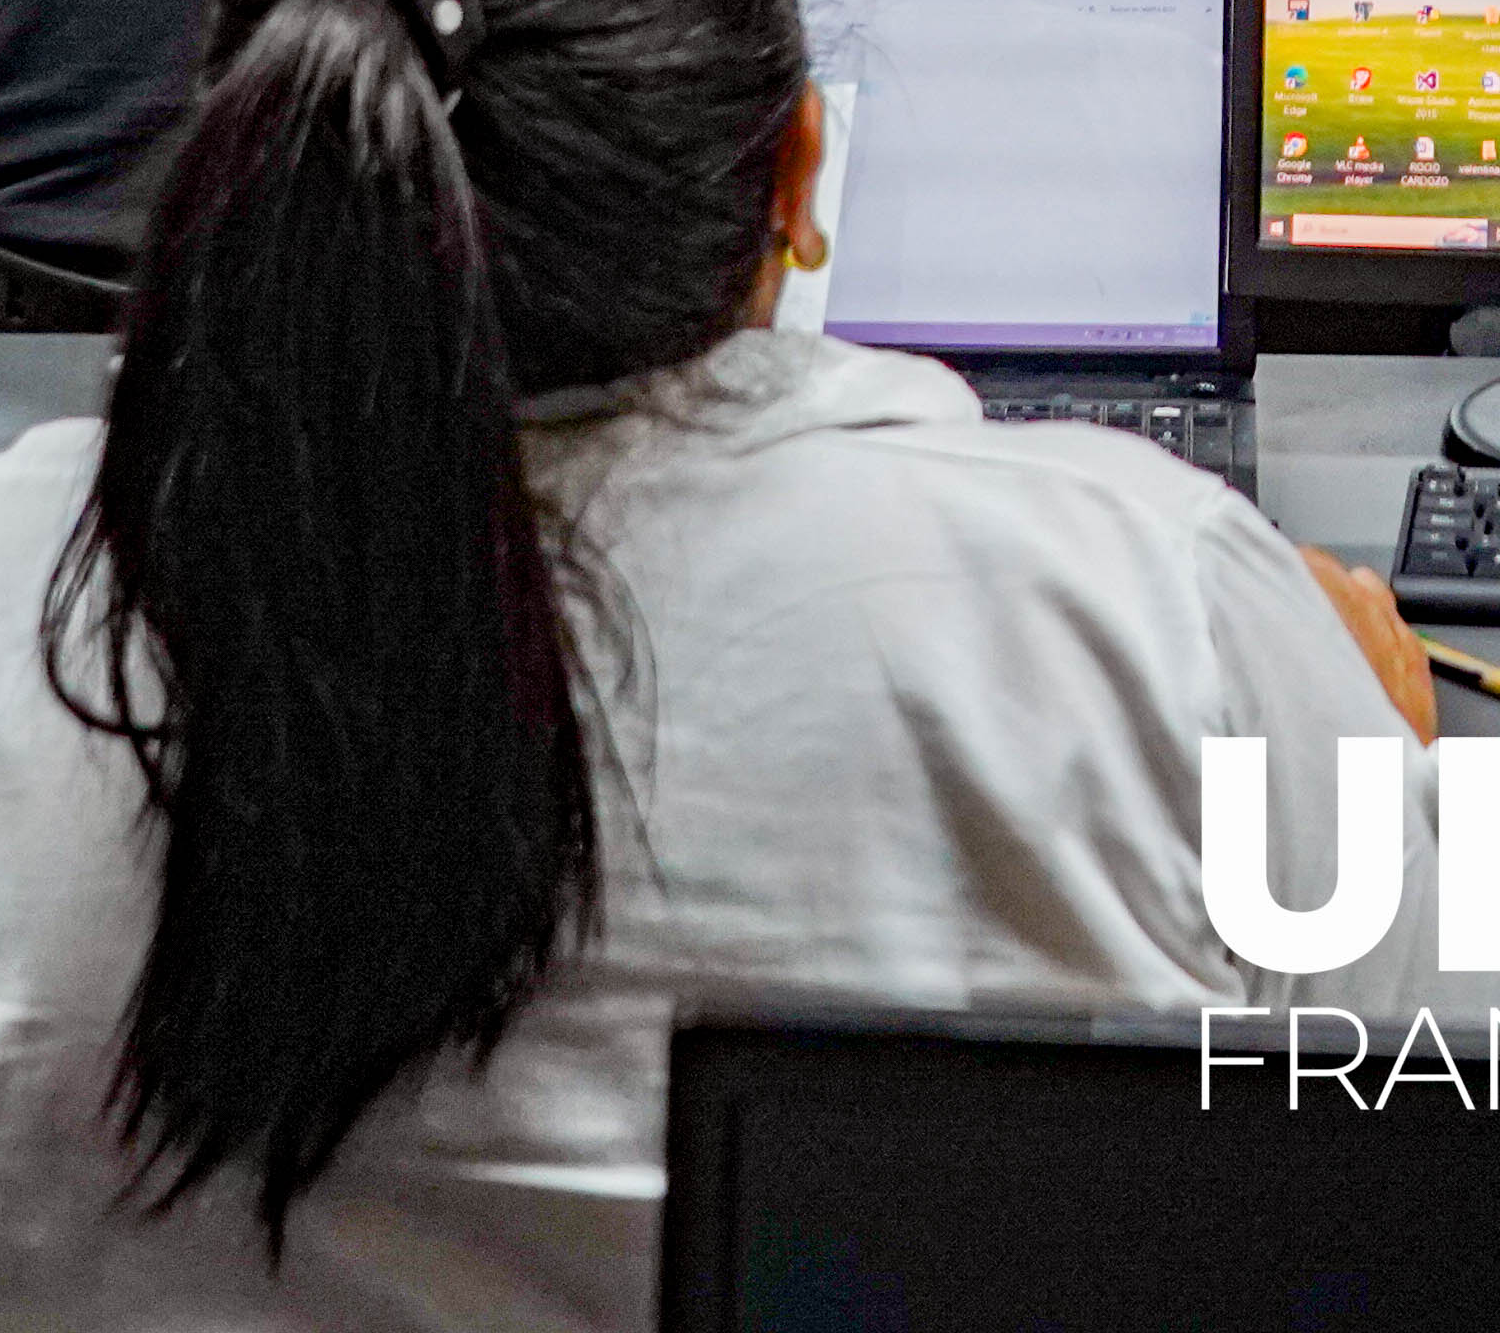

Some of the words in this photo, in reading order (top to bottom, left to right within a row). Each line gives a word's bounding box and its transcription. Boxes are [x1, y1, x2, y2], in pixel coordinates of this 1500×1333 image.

[1284, 106, 1307, 117] Edge
[1277, 159, 1311, 170] Google
[1355, 161, 1384, 172] media
[1409, 162, 1440, 173] ROCIO
[1459, 164, 1500, 175] valentina
[1276, 172, 1313, 183] Chrome
[1345, 175, 1373, 187] player
[1400, 175, 1449, 186] CARDOZO
